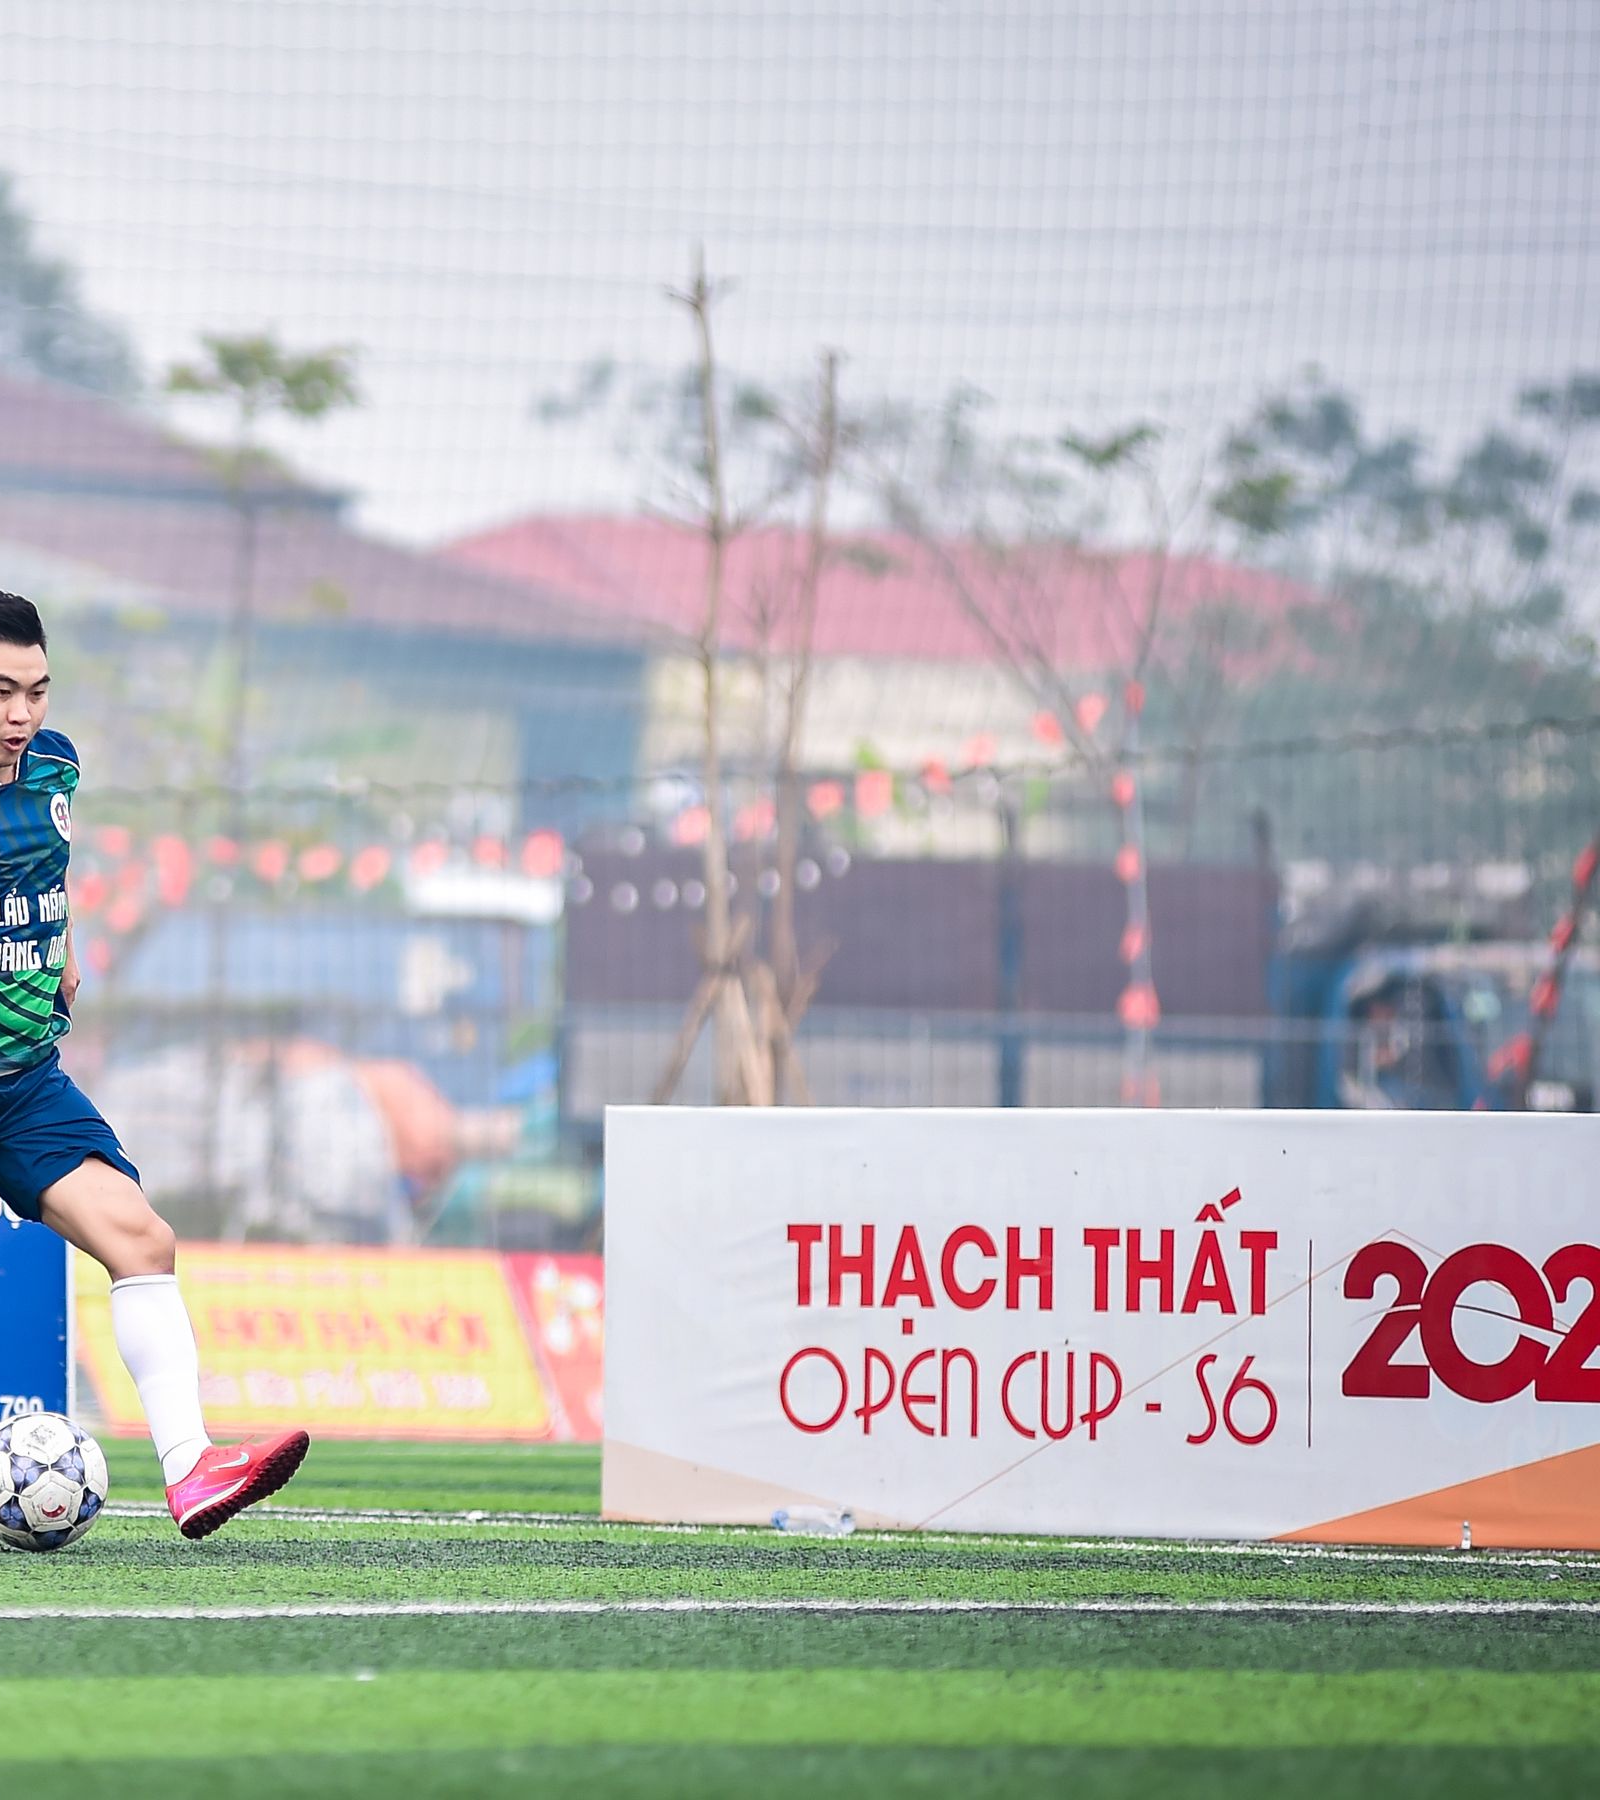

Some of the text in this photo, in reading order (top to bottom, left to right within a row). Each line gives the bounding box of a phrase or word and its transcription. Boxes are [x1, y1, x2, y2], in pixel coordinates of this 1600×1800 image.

[787, 1186, 1278, 1335] THẠCH THẤT
[1002, 1350, 1122, 1441] CUP
[1186, 1353, 1278, 1445] S6
